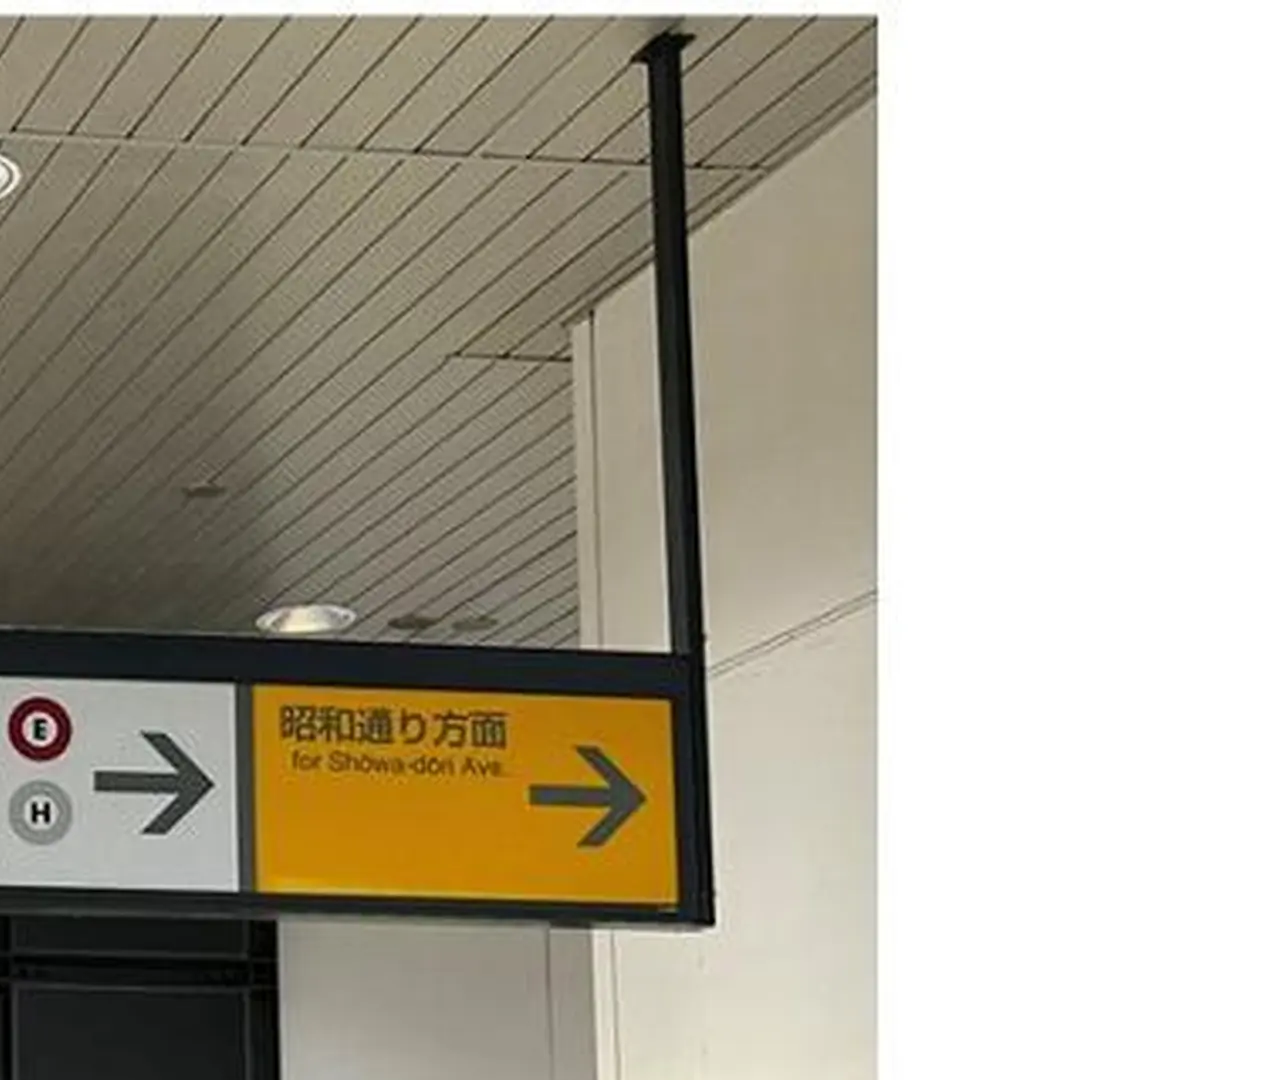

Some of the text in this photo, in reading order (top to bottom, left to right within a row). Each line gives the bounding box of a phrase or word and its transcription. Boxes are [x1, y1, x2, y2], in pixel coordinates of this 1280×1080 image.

[32, 718, 50, 742] E
[279, 704, 509, 750] 昭和通り方面
[290, 750, 321, 772] for
[462, 755, 510, 779] Ave.
[31, 804, 52, 824] H
